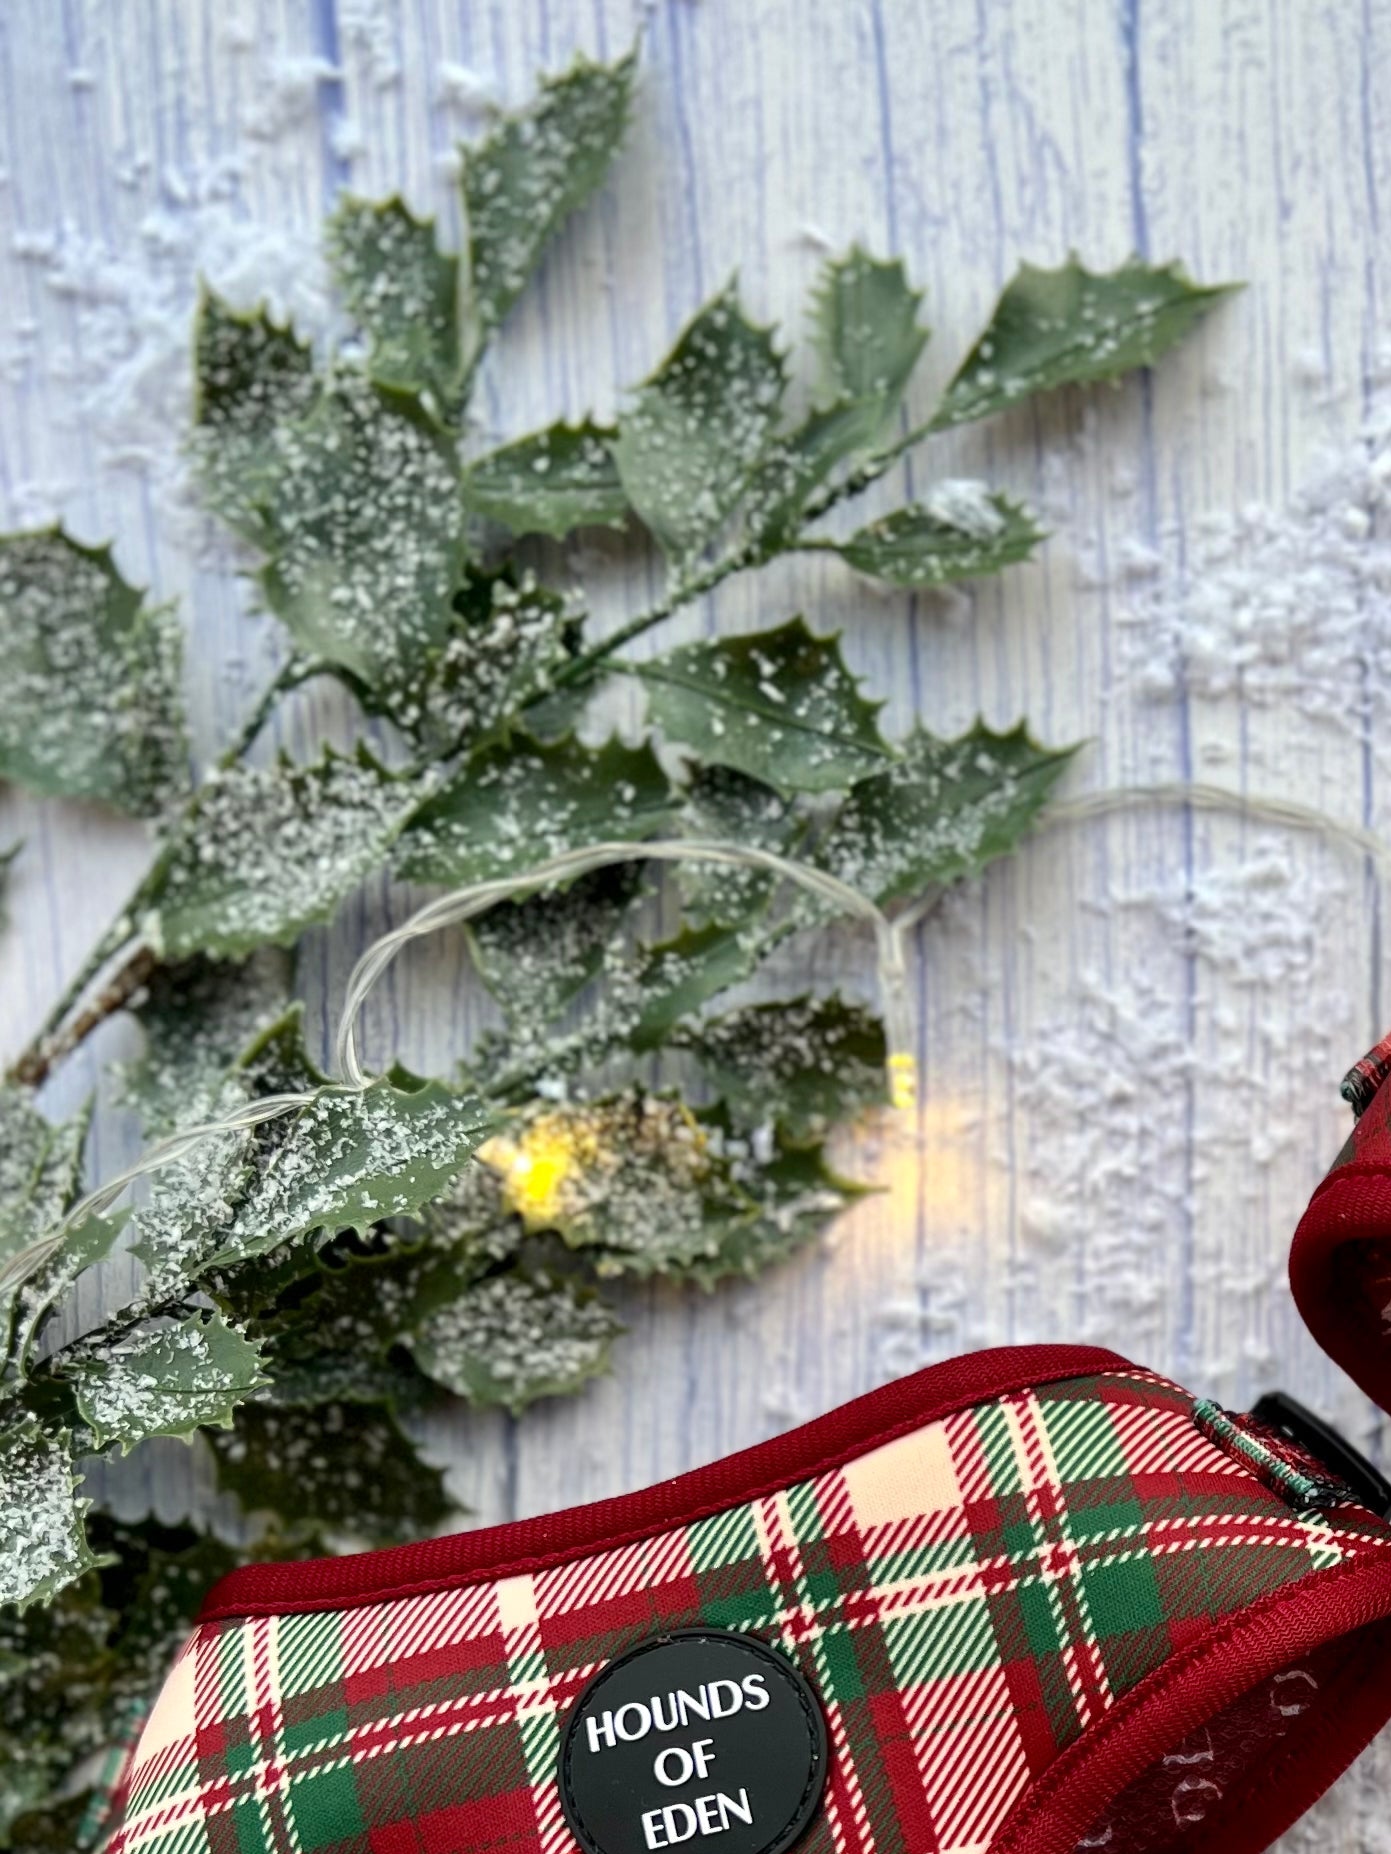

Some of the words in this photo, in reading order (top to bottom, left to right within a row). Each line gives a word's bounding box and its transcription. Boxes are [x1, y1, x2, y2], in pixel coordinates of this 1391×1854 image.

[586, 1674, 770, 1752] HOUNDS
[653, 1739, 715, 1786] OF
[641, 1788, 753, 1850] EDEN
